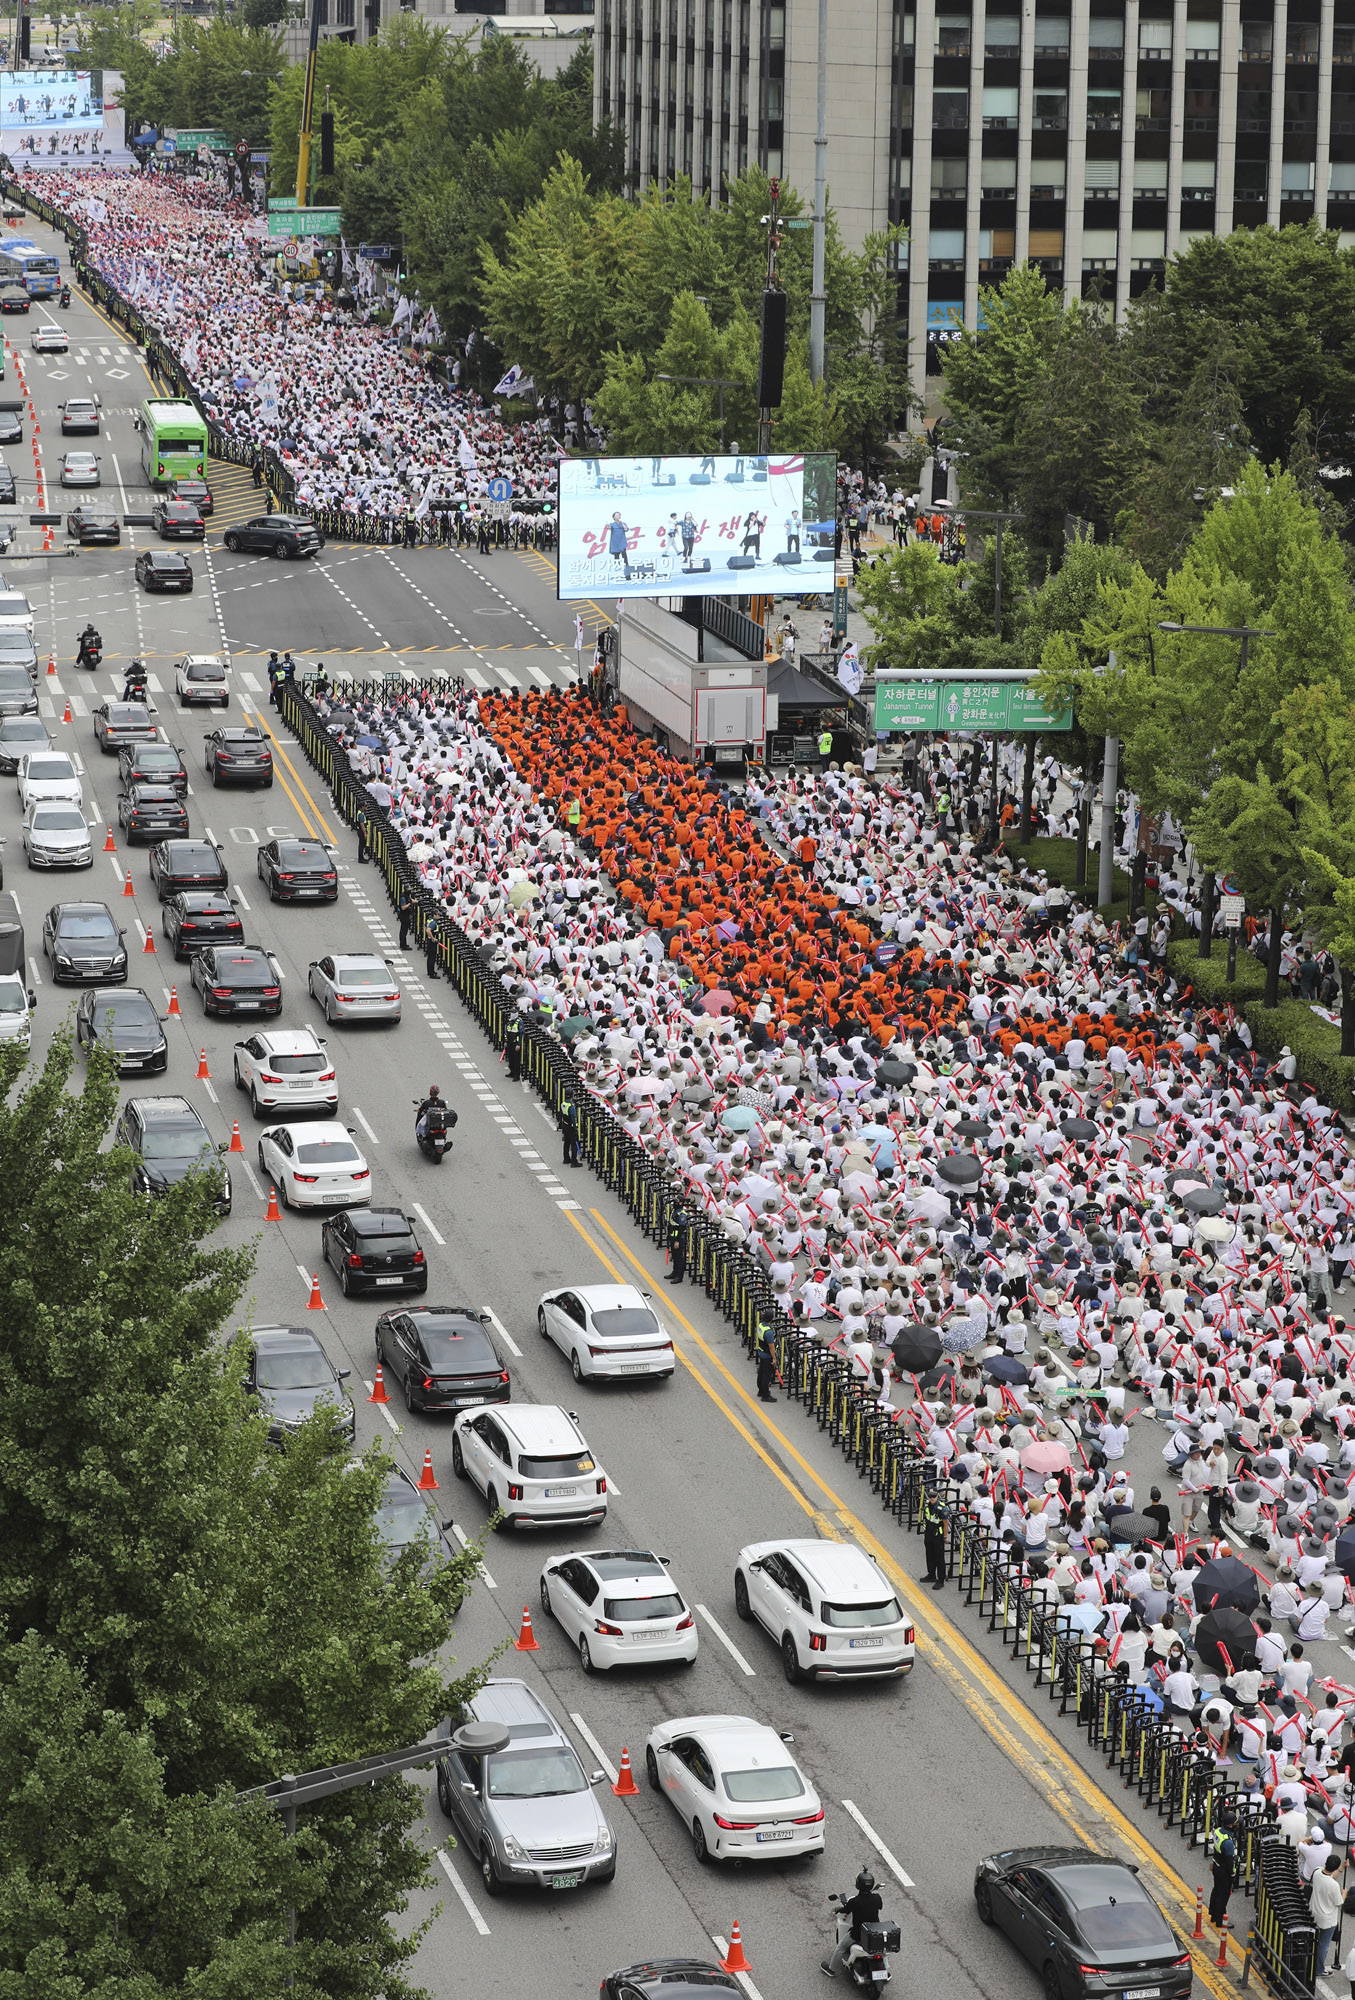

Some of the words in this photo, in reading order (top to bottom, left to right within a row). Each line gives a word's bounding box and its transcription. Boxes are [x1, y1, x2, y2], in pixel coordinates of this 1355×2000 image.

[285, 246, 296, 255] 40
[884, 688, 937, 701] 자하문터널
[962, 686, 1000, 698] 흥인지문
[883, 702, 911, 710] Jahamun
[914, 702, 935, 710] Tunnel
[962, 708, 988, 720] 광화문
[778, 1830, 792, 1838] 6721
[553, 1879, 576, 1888] 4829
